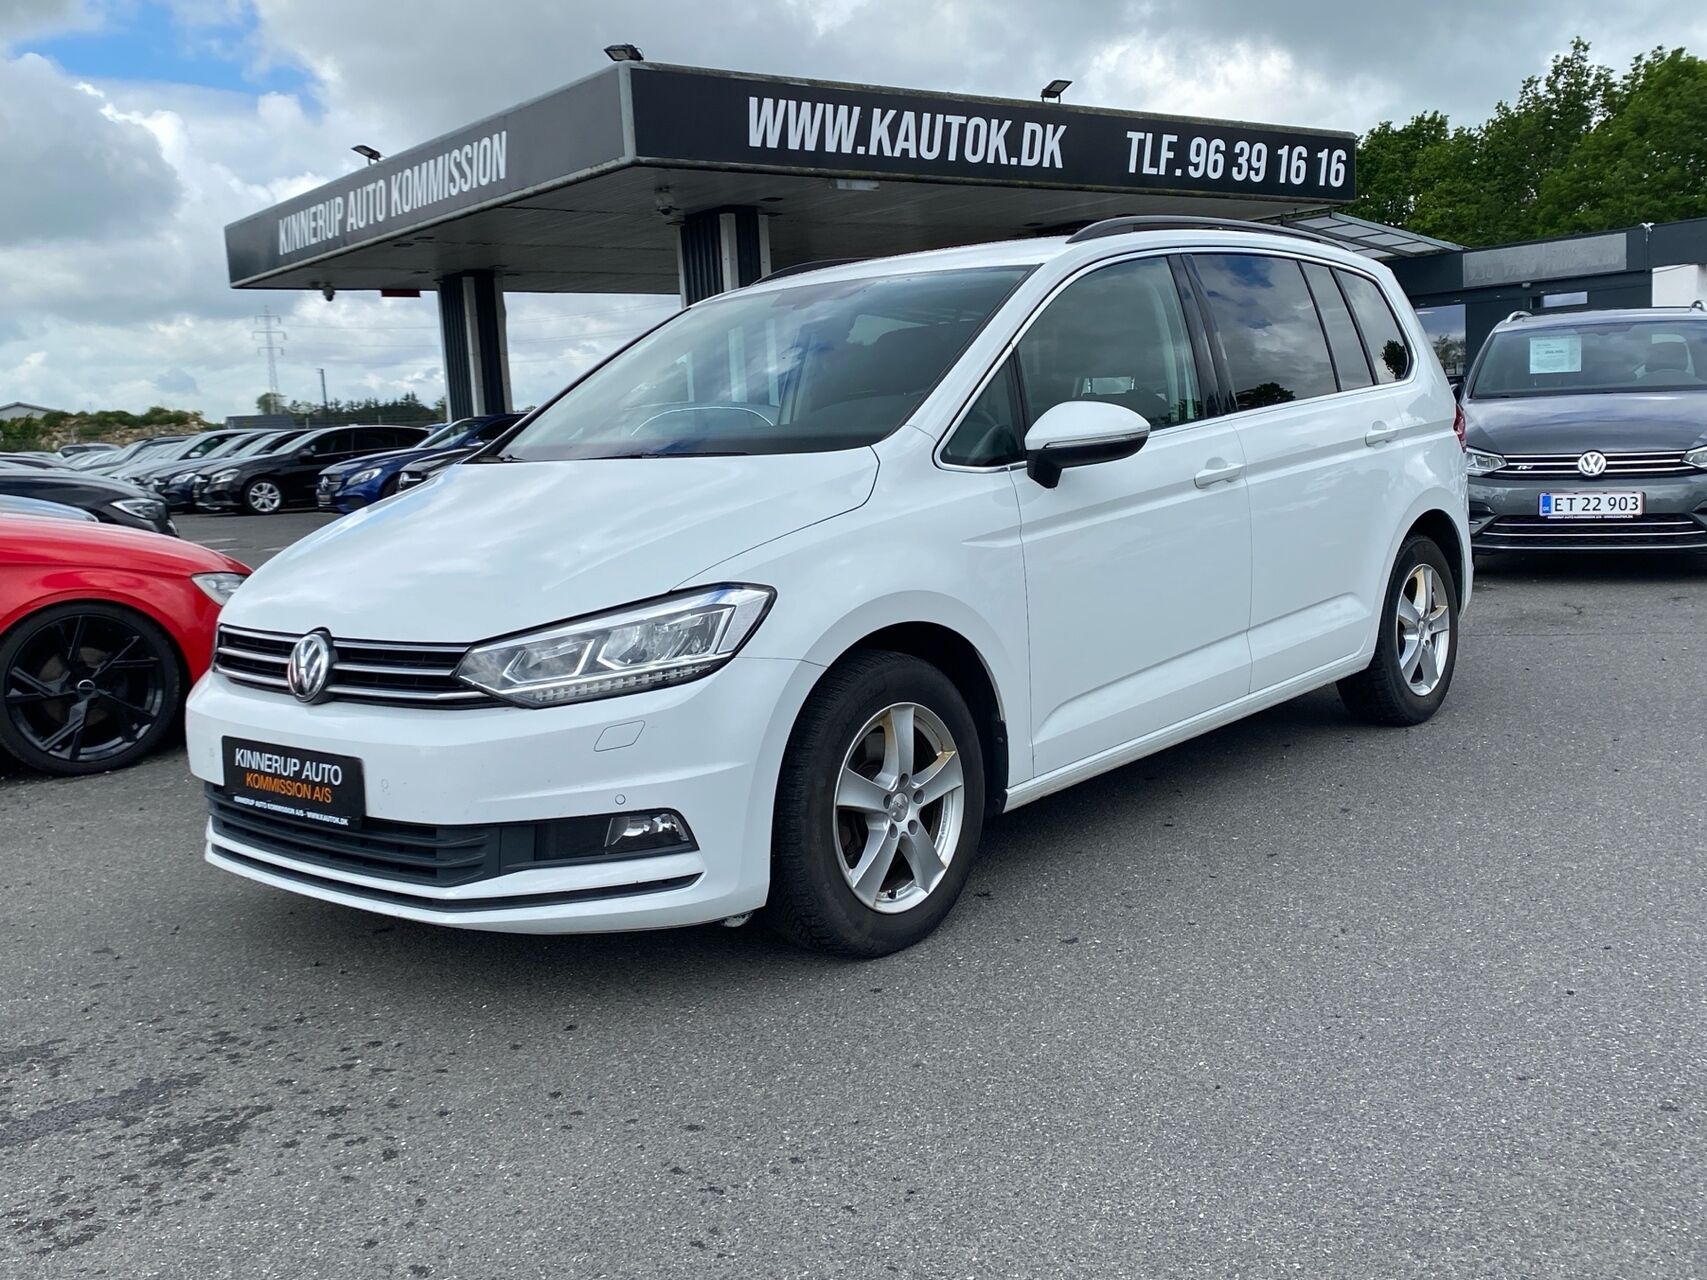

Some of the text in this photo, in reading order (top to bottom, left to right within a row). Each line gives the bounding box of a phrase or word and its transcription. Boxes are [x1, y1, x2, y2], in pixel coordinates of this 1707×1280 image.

[748, 96, 1067, 170] WWW.KAUTOK.DK
[1126, 131, 1347, 188] TLF. 96 39 16 16
[279, 131, 507, 255] KINNERUP AUTO KOMMISSION
[1555, 496, 1639, 512] ET 22 903
[234, 748, 342, 785] KINNERUP AUTO
[246, 772, 332, 803] KOMMISSION A/S
